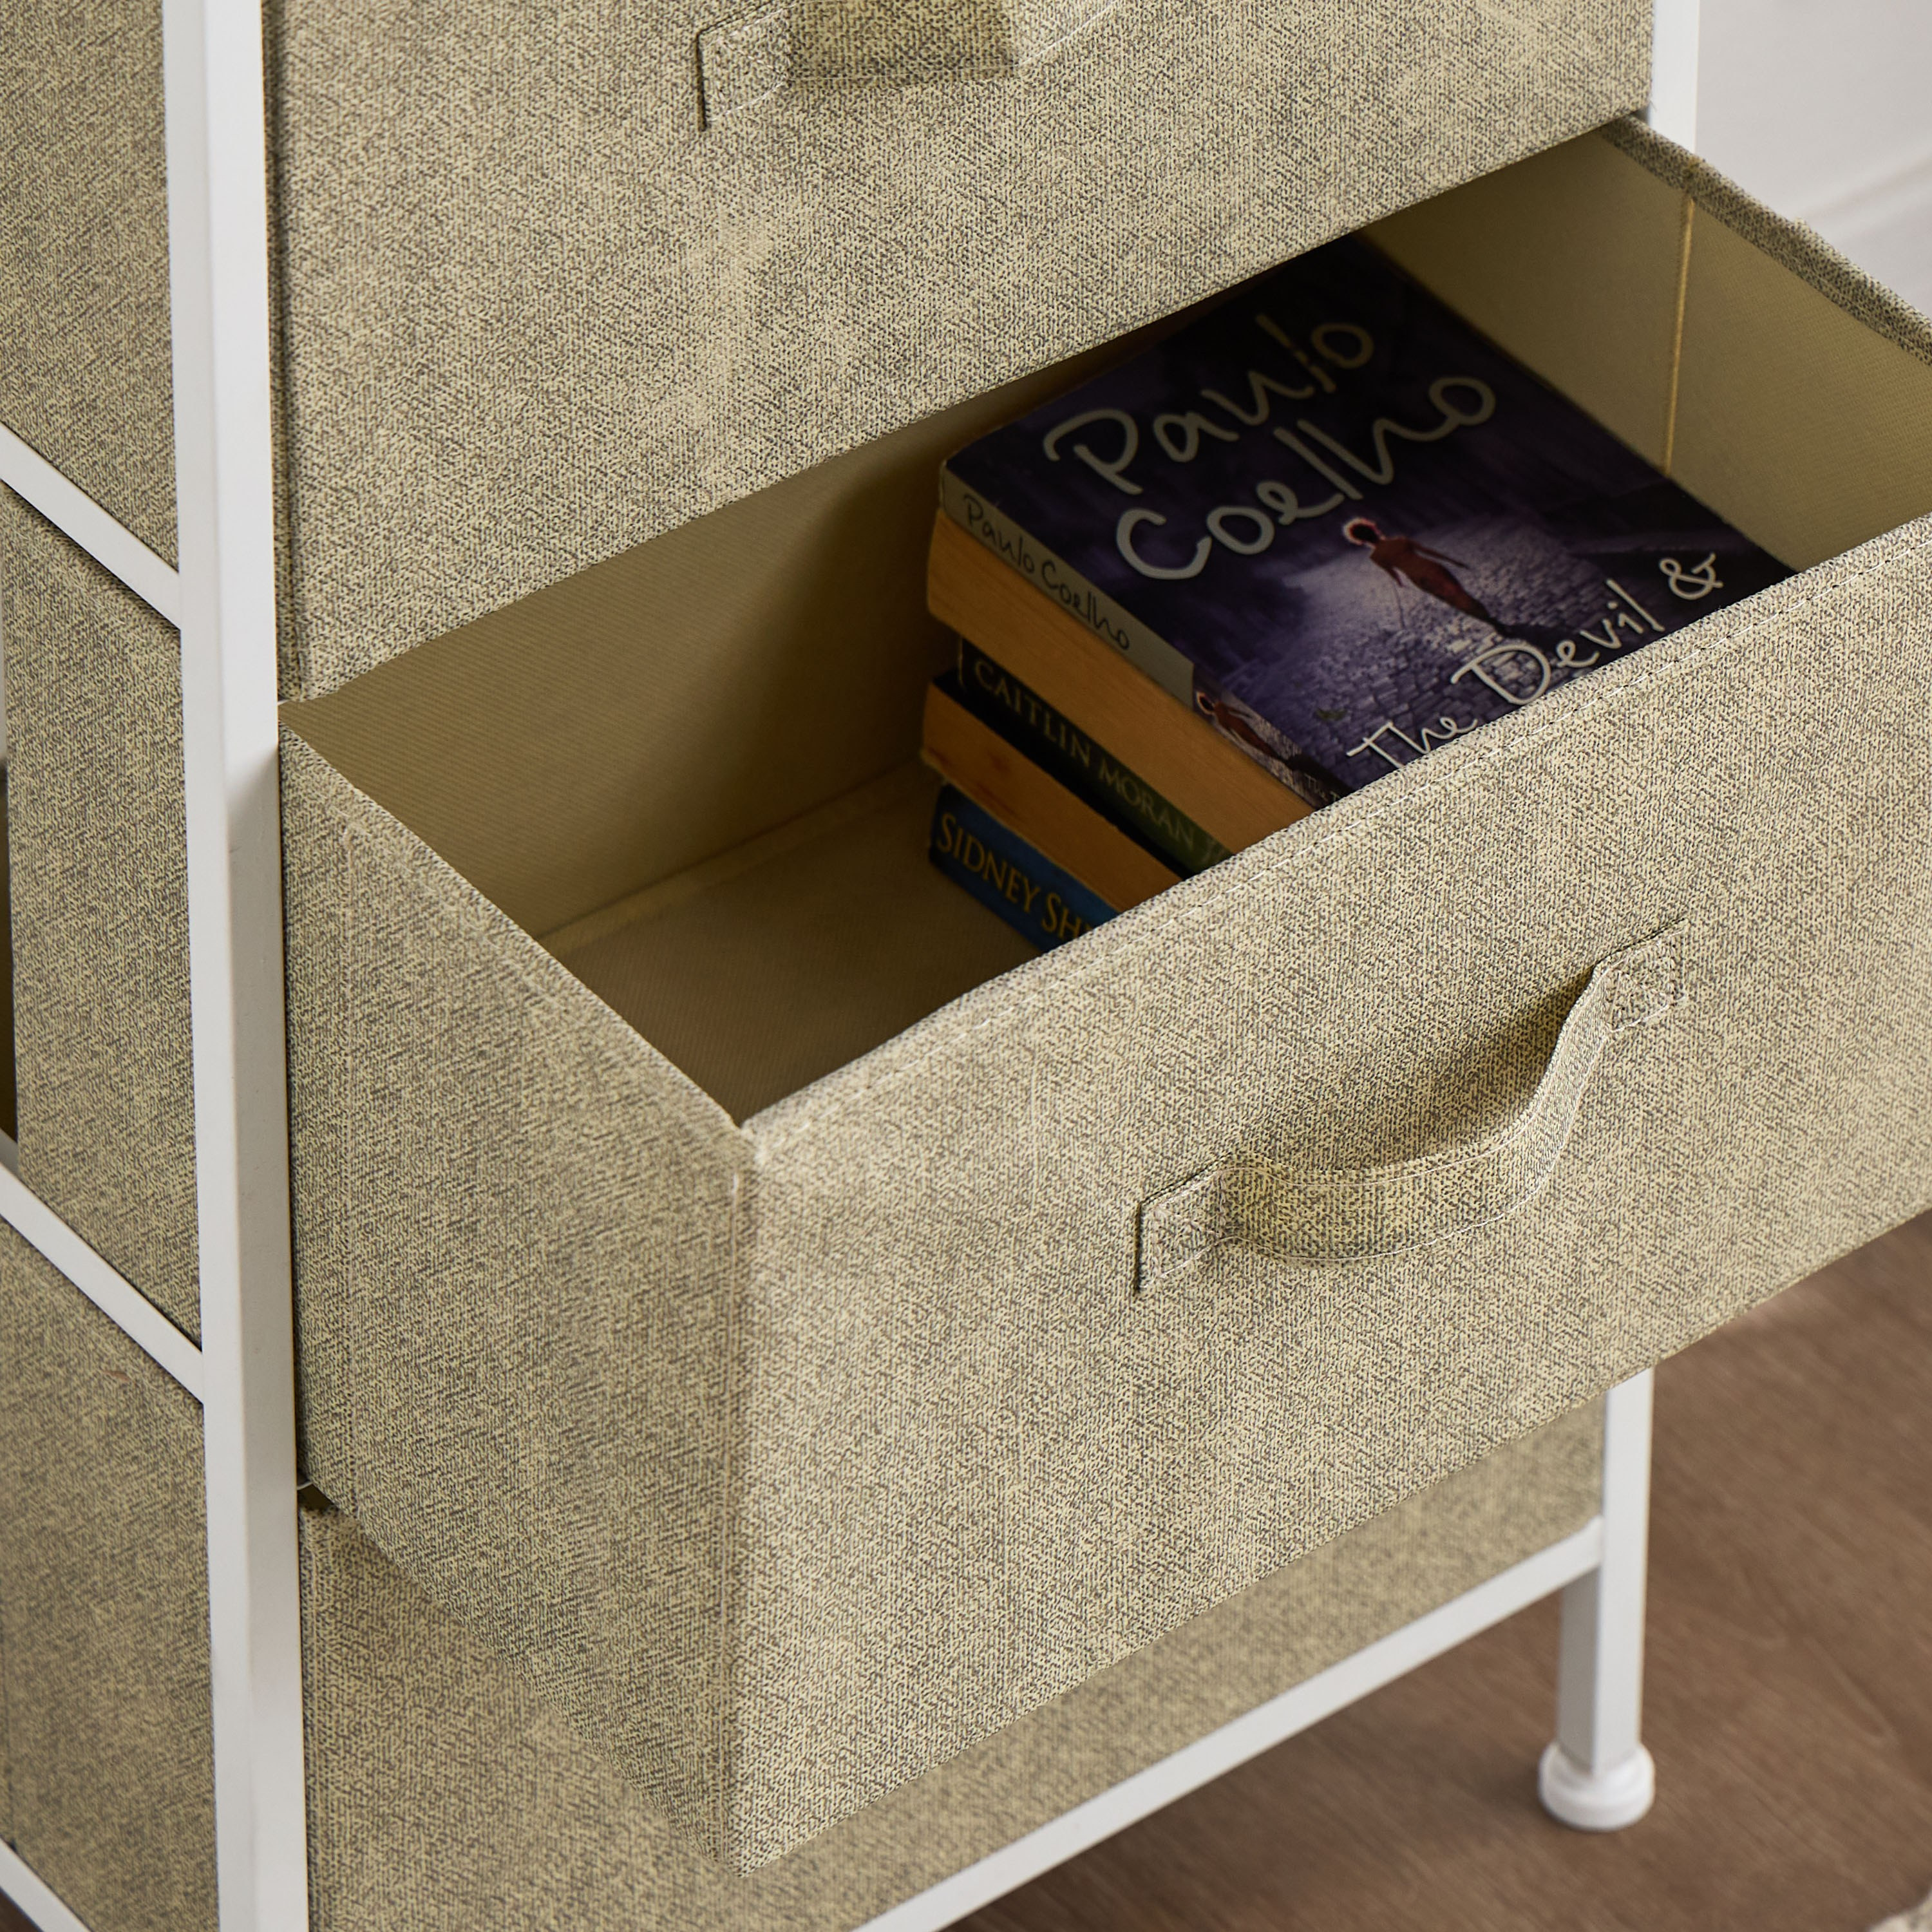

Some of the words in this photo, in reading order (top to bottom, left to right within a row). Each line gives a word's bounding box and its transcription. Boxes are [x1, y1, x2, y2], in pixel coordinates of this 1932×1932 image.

[1043, 314, 1374, 495] Paulo
[1116, 376, 1496, 580] Coelho
[963, 493, 1035, 573] Paulo
[1041, 561, 1130, 650] Coelho
[1346, 717, 1478, 768] The
[1450, 578, 1665, 705] Devil
[1659, 553, 1723, 600] &
[974, 659, 1092, 768] CAITLIN
[1097, 758, 1196, 851] MORAN
[936, 813, 1041, 913] SIDNEY
[1041, 892, 1094, 939] SH
